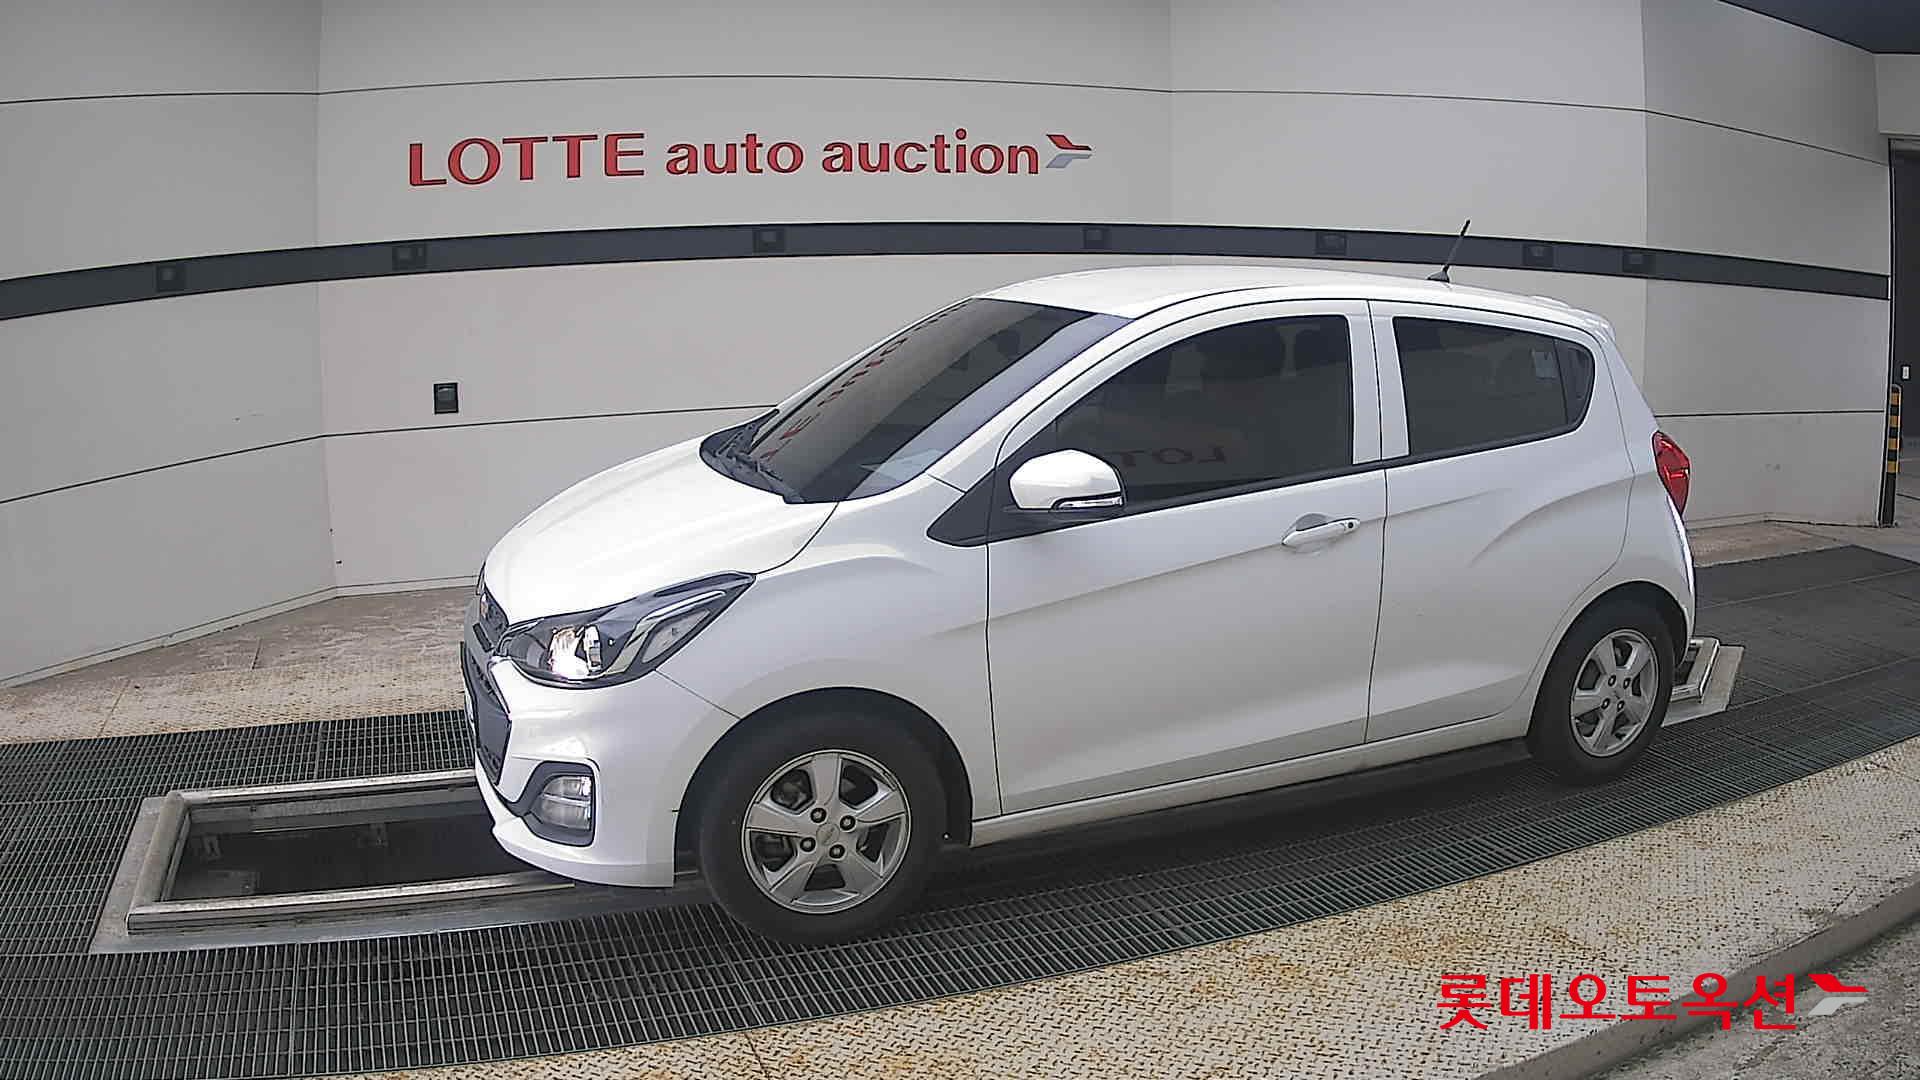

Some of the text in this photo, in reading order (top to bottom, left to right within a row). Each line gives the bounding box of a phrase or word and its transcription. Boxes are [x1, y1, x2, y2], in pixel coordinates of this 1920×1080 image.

[408, 128, 1041, 187] LOTTE auto auction
